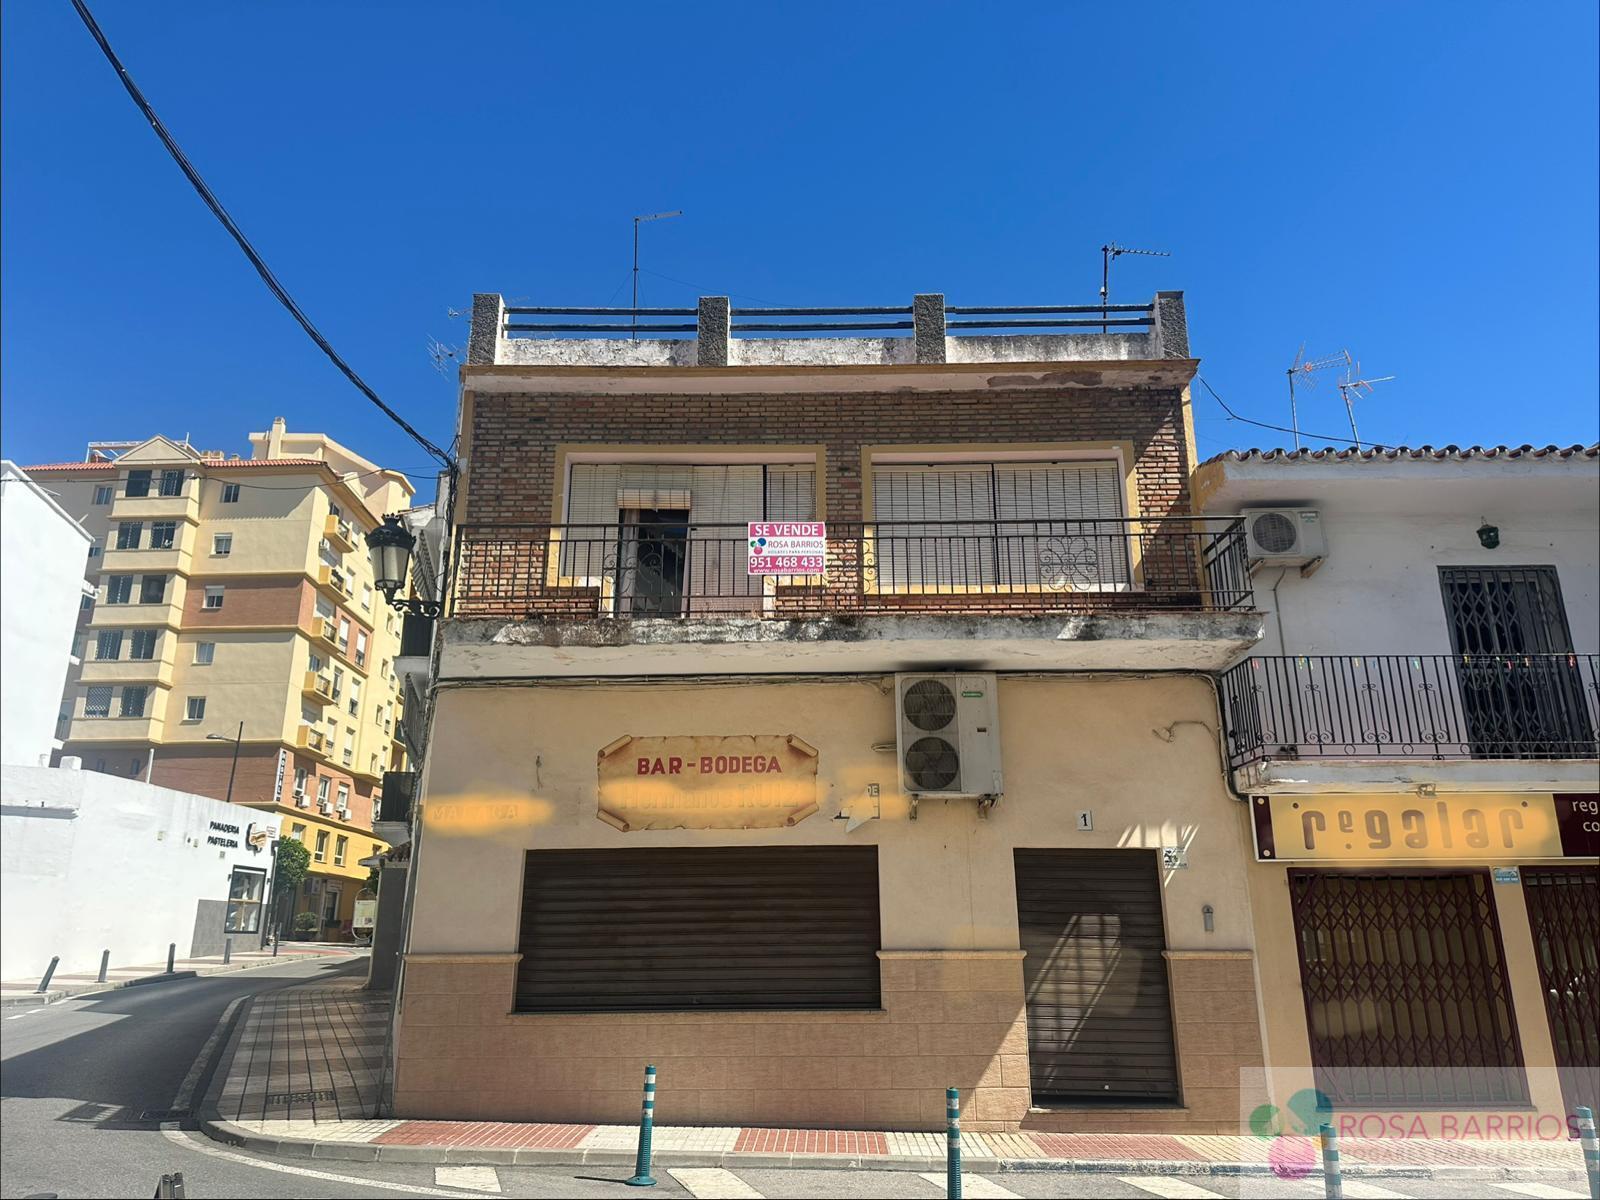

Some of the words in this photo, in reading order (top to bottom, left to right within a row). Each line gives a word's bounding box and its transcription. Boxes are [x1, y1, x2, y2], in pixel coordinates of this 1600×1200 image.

[755, 524, 769, 536] SE
[774, 524, 818, 536] VENDE
[768, 540, 789, 549] ROSA
[790, 540, 824, 549] BARRIOS
[750, 557, 772, 568] 951
[775, 557, 798, 568] 468
[801, 557, 823, 568] 433
[637, 757, 682, 776] BAR
[700, 755, 783, 775] BODEGA
[1572, 800, 1599, 815] reg
[1081, 813, 1088, 826] 1
[1301, 801, 1524, 850] regalar
[209, 820, 240, 835] PANADERIA
[206, 835, 239, 849] PASTELERIA
